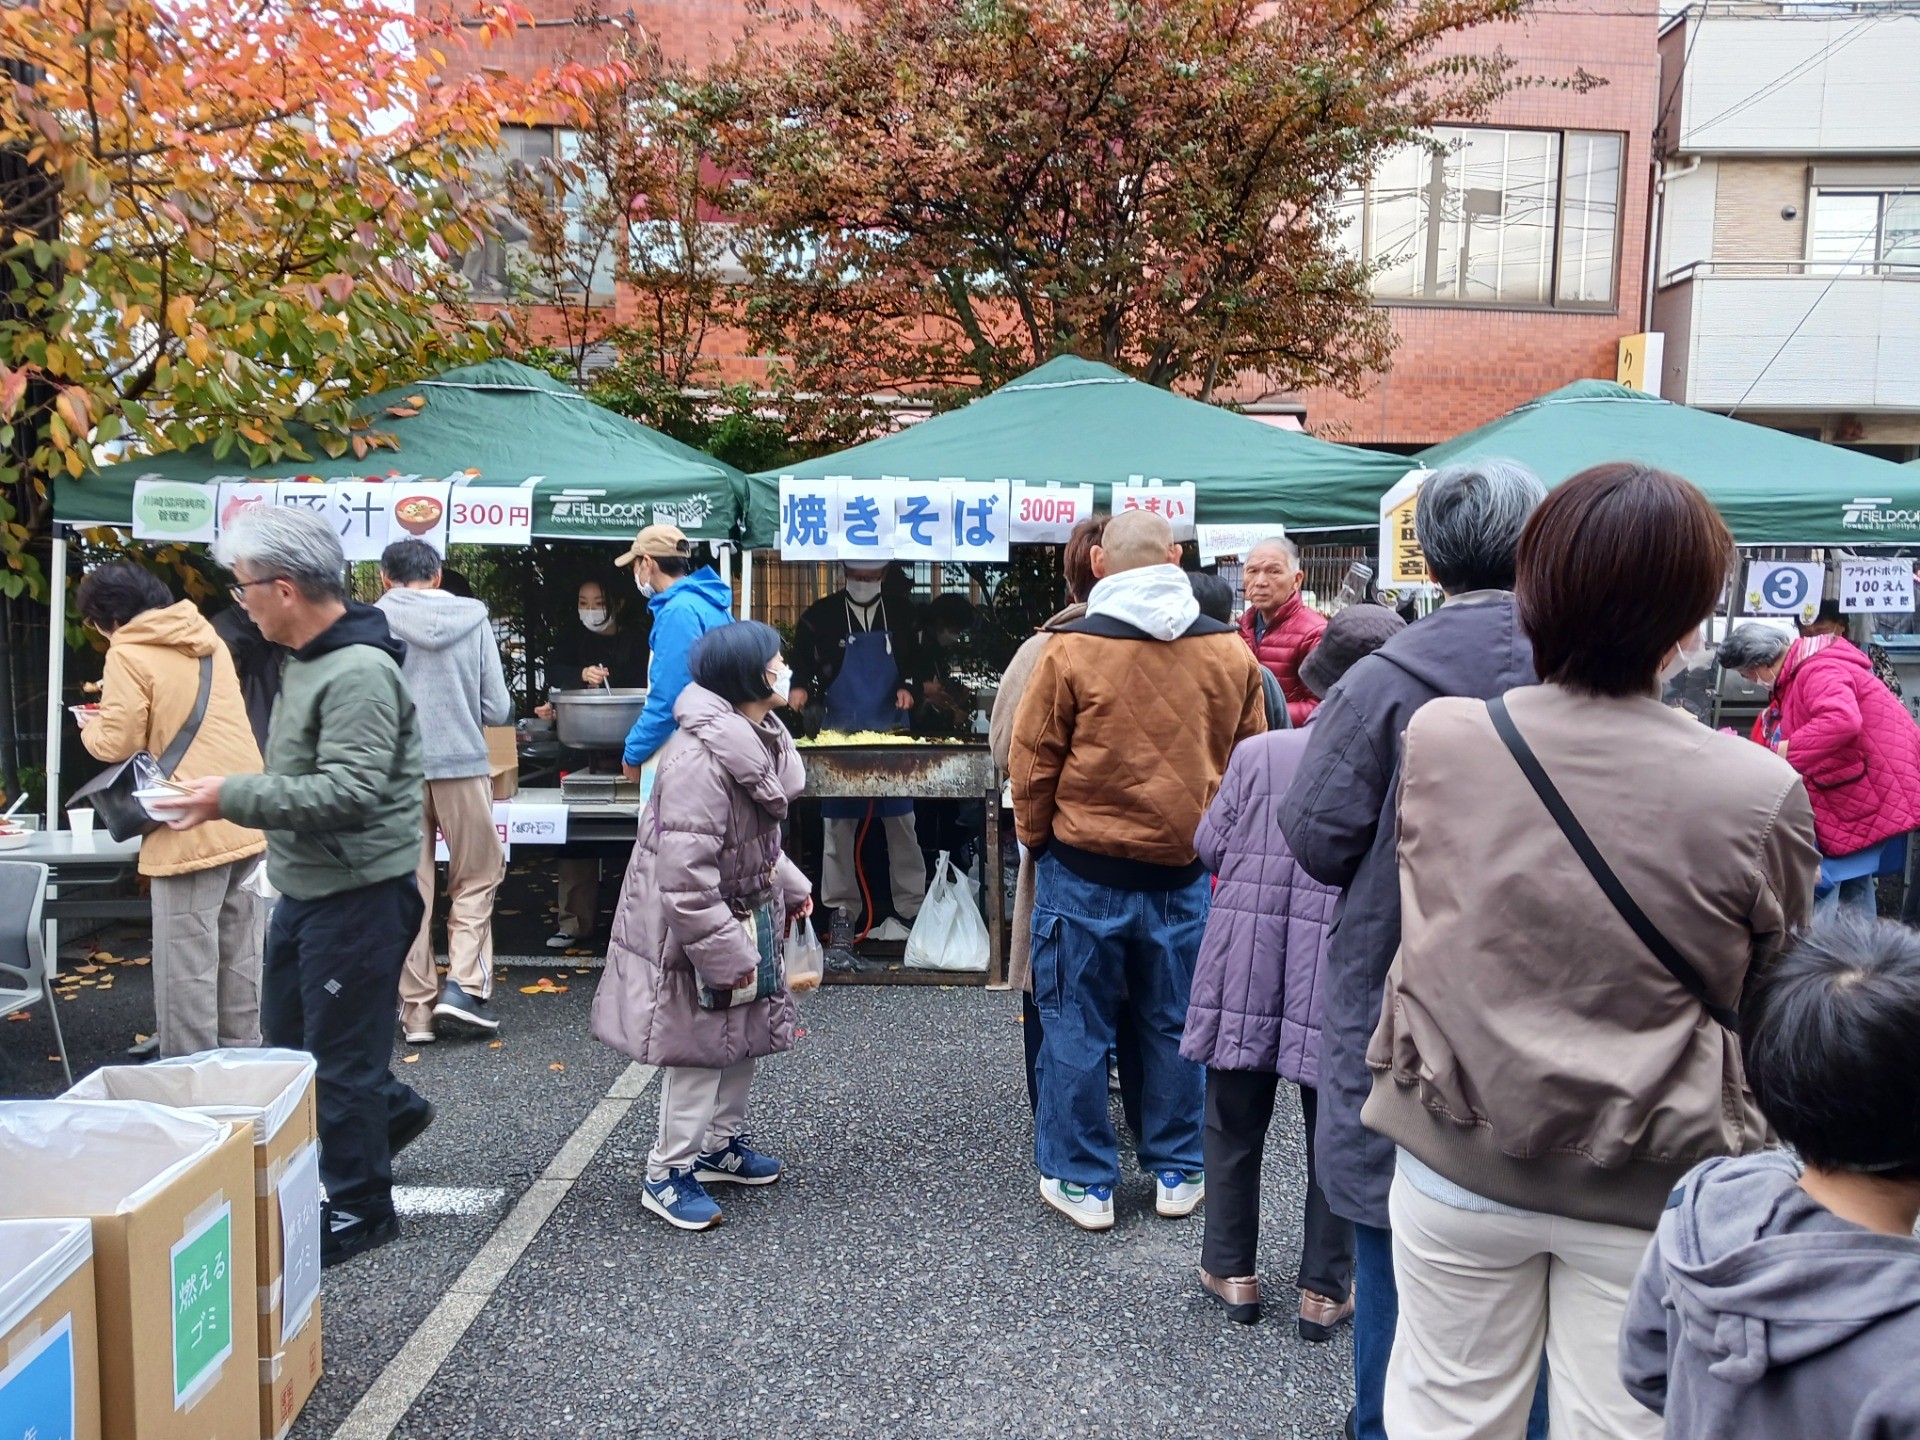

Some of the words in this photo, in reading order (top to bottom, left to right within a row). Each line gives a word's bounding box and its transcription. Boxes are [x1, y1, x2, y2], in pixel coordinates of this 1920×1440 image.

[452, 503, 529, 527] 300円
[550, 514, 586, 524] Powered
[587, 516, 598, 527] by
[571, 502, 646, 518] FIELDOOR
[782, 493, 1000, 547] 焼きそば
[1019, 497, 1076, 524] 300円
[1861, 509, 1920, 523] FIELDOO
[1771, 568, 1800, 606] 3
[179, 1250, 226, 1315] 燃える
[190, 1306, 217, 1349] ゴミ
